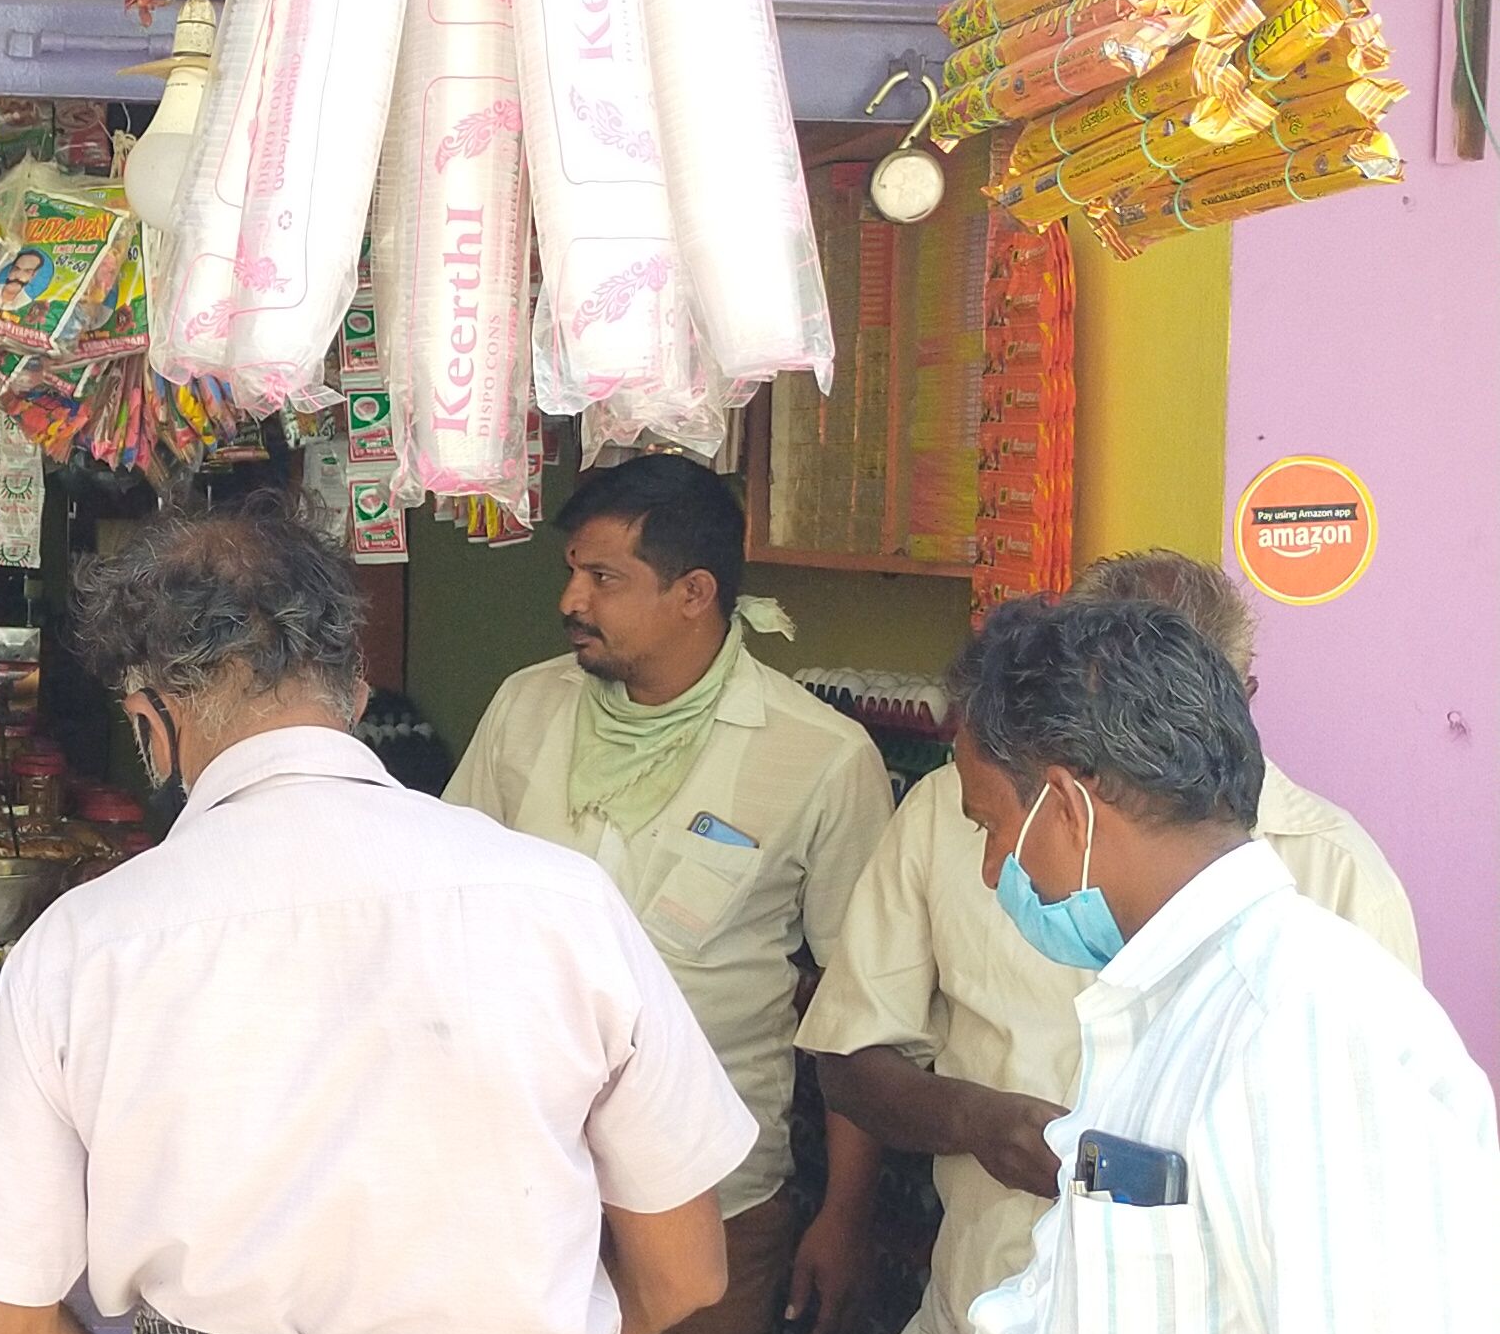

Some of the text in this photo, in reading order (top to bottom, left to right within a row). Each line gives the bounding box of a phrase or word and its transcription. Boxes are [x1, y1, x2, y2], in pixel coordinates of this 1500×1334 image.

[479, 314, 501, 437] DISPO CONS
[1257, 508, 1351, 522] Pay using Amazon app
[1258, 524, 1352, 548] amazon
